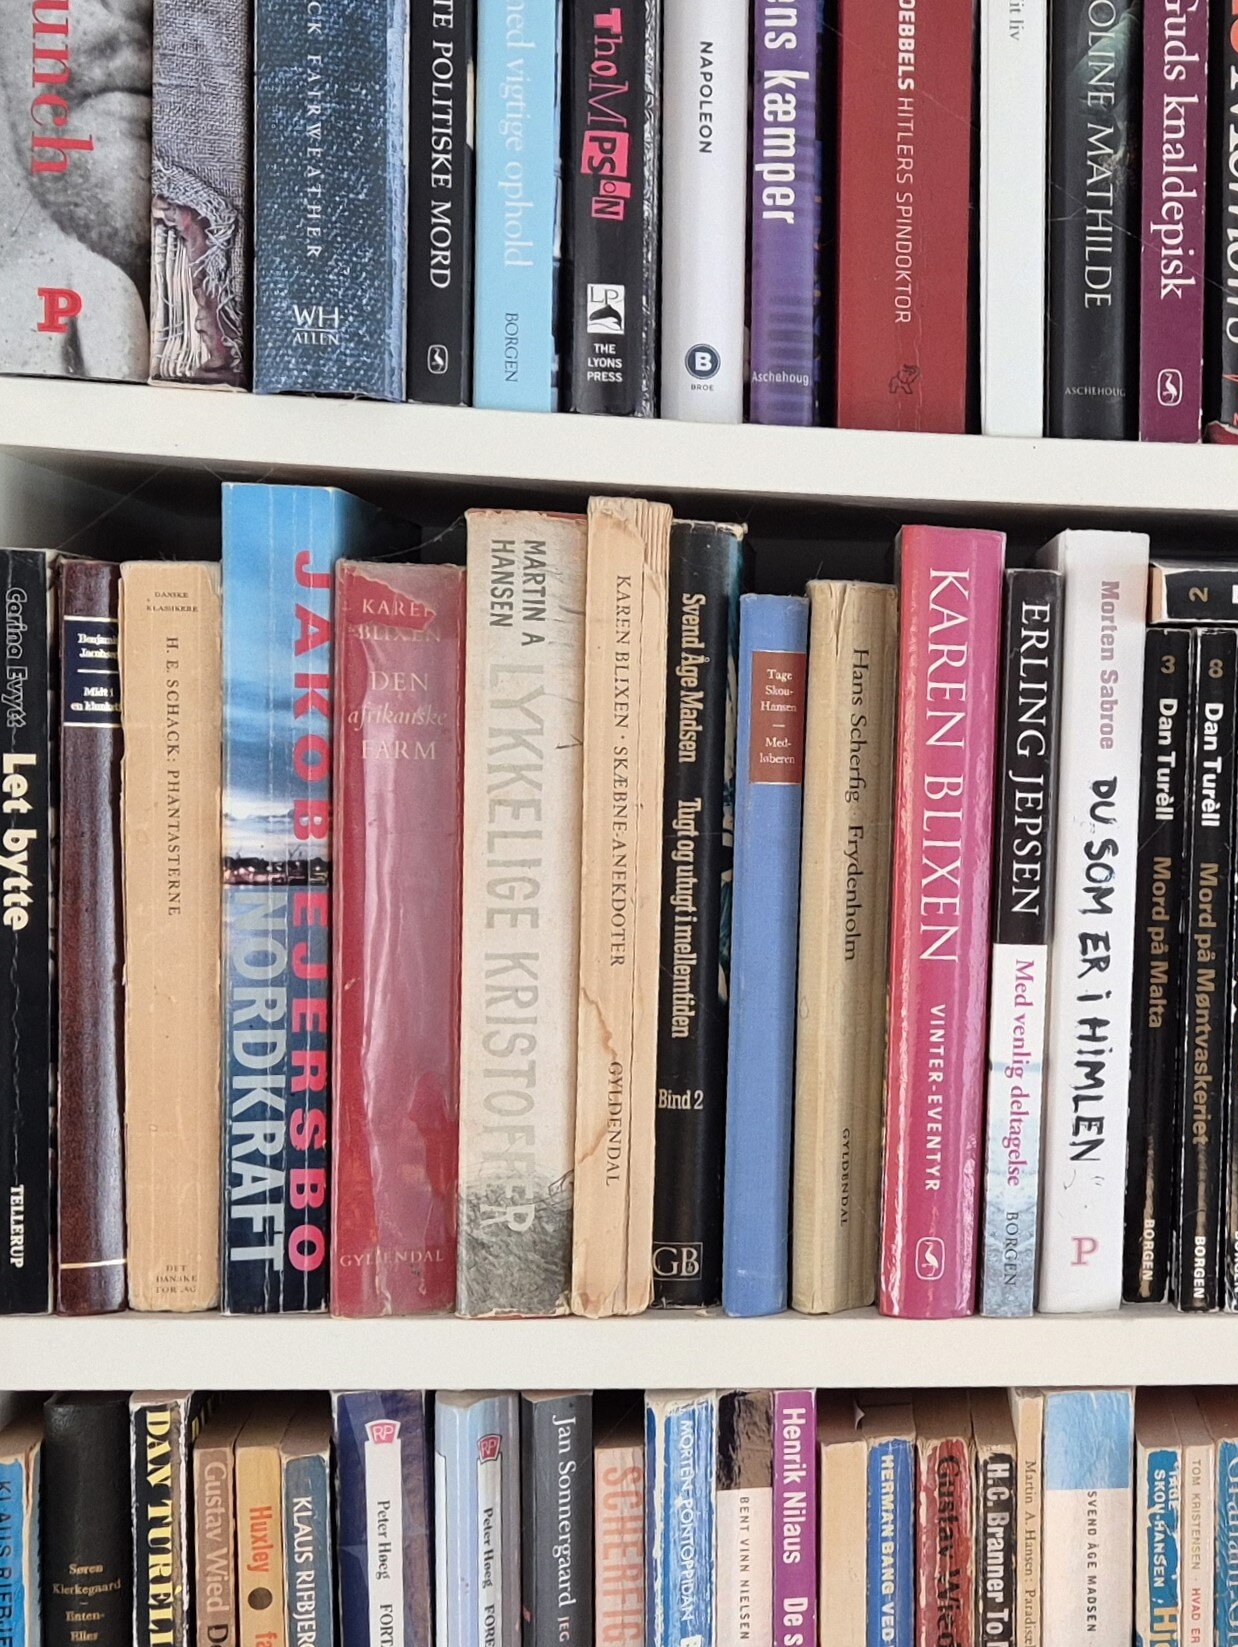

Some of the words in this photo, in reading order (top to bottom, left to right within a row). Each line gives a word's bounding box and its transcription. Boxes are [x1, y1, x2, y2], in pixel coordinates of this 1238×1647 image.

[432, 42, 453, 188] POLITISKE
[501, 58, 534, 152] vigtige
[699, 41, 713, 154] NAPOLEON
[307, 55, 322, 258] FAIRWEATHER
[755, 70, 808, 223] kæmper
[896, 98, 914, 184] HITLERS
[498, 162, 533, 268] ophold
[1085, 123, 1114, 309] MATHILDE
[1151, 94, 1199, 300] knaldepisk
[429, 201, 452, 288] MORD
[895, 193, 912, 323] SPINDOKTOR
[37, 288, 81, 332] P
[293, 305, 339, 327] WH
[588, 358, 622, 368] LYONS
[588, 371, 622, 382] PRESS
[594, 344, 615, 354] THE
[1064, 387, 1126, 396] ASCHEHOUG
[489, 540, 515, 627] HANSEN
[522, 540, 546, 622] MARTIN
[615, 575, 632, 645] KAREN
[521, 632, 545, 646] A
[1100, 581, 1120, 661] Morten
[371, 671, 428, 692] DEN
[614, 652, 630, 728] BLIXEN
[765, 684, 793, 696] Skou-
[767, 669, 792, 682] Tage
[851, 648, 870, 706] Hans
[926, 568, 970, 749] KAREN
[1016, 602, 1050, 758] ERLING
[1161, 655, 1175, 674] 3
[1209, 659, 1223, 678] 8
[166, 679, 180, 762] SCHACK:
[293, 550, 332, 841] JAKOB
[761, 701, 797, 712] Hansen
[1100, 669, 1119, 750] Sabroe
[361, 741, 436, 760] FARM
[765, 737, 791, 748] Med-
[844, 715, 867, 803] Scherfig
[2, 753, 37, 814] Let
[484, 663, 545, 930] LYKKELIGE
[167, 771, 181, 916] PHANTASTERNE
[920, 775, 964, 963] BLIXEN
[1009, 771, 1045, 916] JEPSEN
[671, 928, 697, 1038] mellemtiden
[1015, 960, 1035, 1007] Med
[1004, 1014, 1031, 1079] venlig
[230, 891, 288, 1271] NORDKRAFT
[288, 892, 328, 1272] EJERSBO
[694, 1090, 703, 1109] 2
[925, 1005, 946, 1191] VINTER-EVENTYR
[605, 1062, 622, 1187] GYLDENDAL
[1003, 1086, 1030, 1186] deltagelse
[840, 1128, 850, 1227] GYLDENDAL
[10, 1185, 24, 1268] TELLERUP
[1142, 1219, 1155, 1281] BORGEN
[1194, 1236, 1206, 1299] BORGEN
[552, 1415, 576, 1456] Jan
[680, 1421, 694, 1496] MORTEN
[783, 1408, 806, 1484] Henrik
[205, 1461, 226, 1541] Gustav
[881, 1454, 894, 1537] HERMAN
[1024, 1460, 1036, 1504] Martin
[1191, 1460, 1201, 1486] TOM
[247, 1506, 273, 1574] Huxley
[292, 1497, 313, 1564] KLAUS
[377, 1500, 390, 1538] Peter
[483, 1507, 494, 1547] Peter
[740, 1497, 750, 1532] BENT
[783, 1492, 806, 1564] Nilaus
[1087, 1492, 1097, 1536] SVEND
[1191, 1493, 1201, 1570] KRISTENSEN
[69, 1565, 103, 1575] Søren
[206, 1548, 229, 1614] Wied
[482, 1551, 494, 1588] Høeg
[602, 1466, 643, 1642] SCHERFIG
[740, 1540, 750, 1572] VINN
[881, 1543, 894, 1596] BANG
[986, 1511, 1010, 1603] Branner
[1087, 1543, 1098, 1569] ÅGE
[70, 1631, 99, 1642] Eller
[740, 1579, 750, 1639] NIELSEN
[881, 1603, 895, 1640] VED
[1087, 1575, 1098, 1632] MADSEN
[1191, 1588, 1201, 1621] HVAD
[1191, 1626, 1201, 1644] ER
